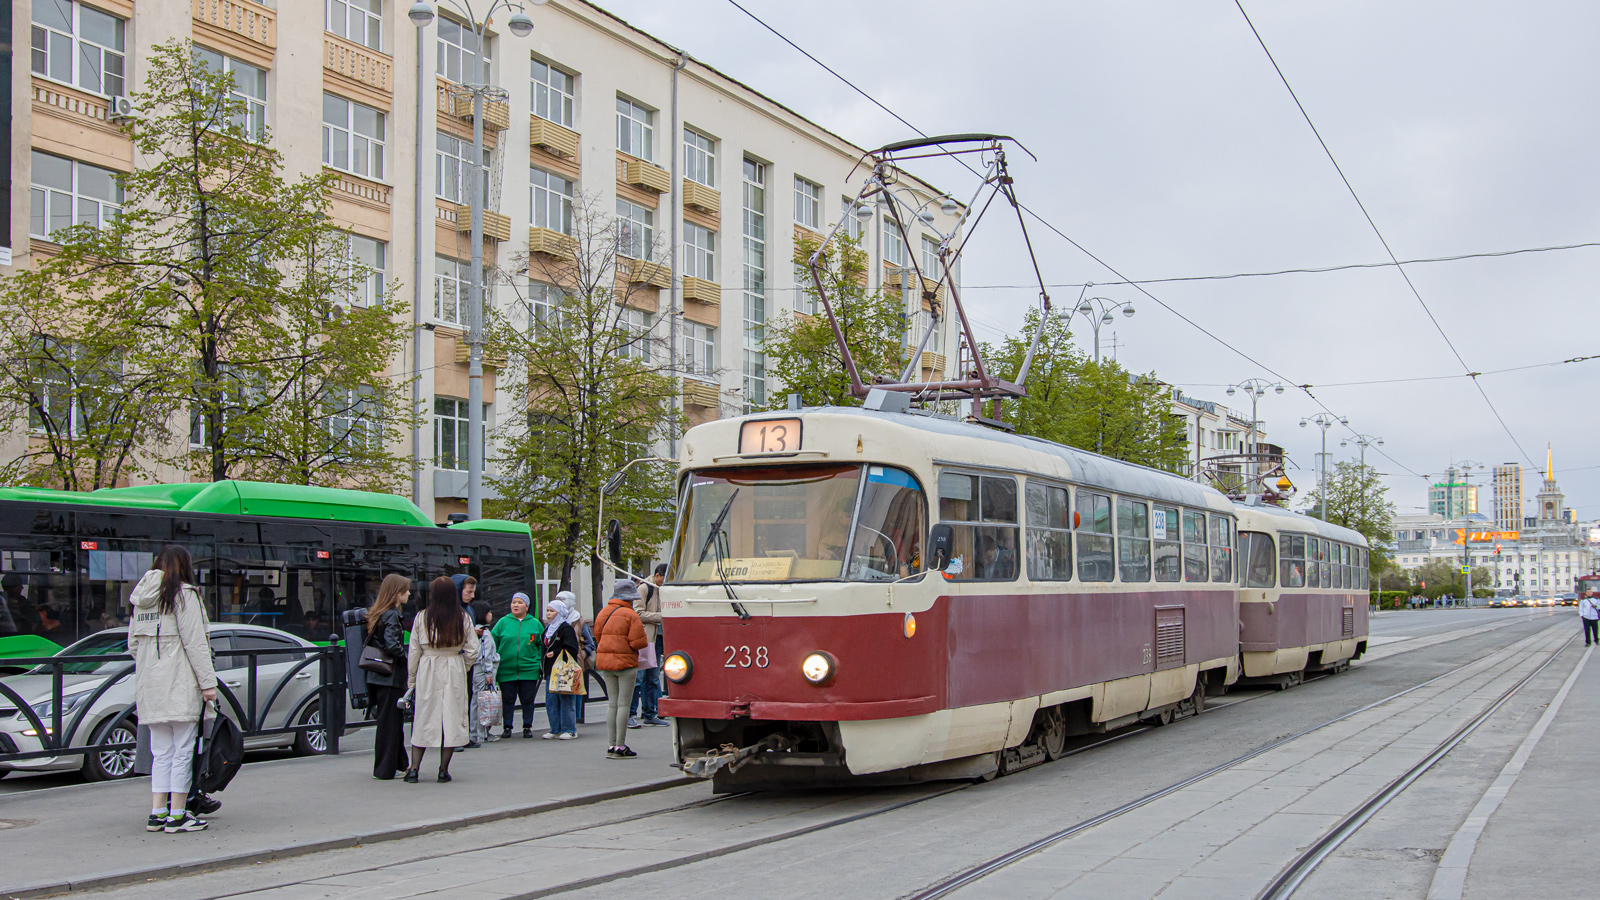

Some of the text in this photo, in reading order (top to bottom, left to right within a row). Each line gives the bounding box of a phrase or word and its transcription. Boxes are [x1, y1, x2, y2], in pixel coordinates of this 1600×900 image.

[760, 425, 787, 452] 13
[1155, 512, 1165, 529] 238
[724, 645, 769, 668] 238
